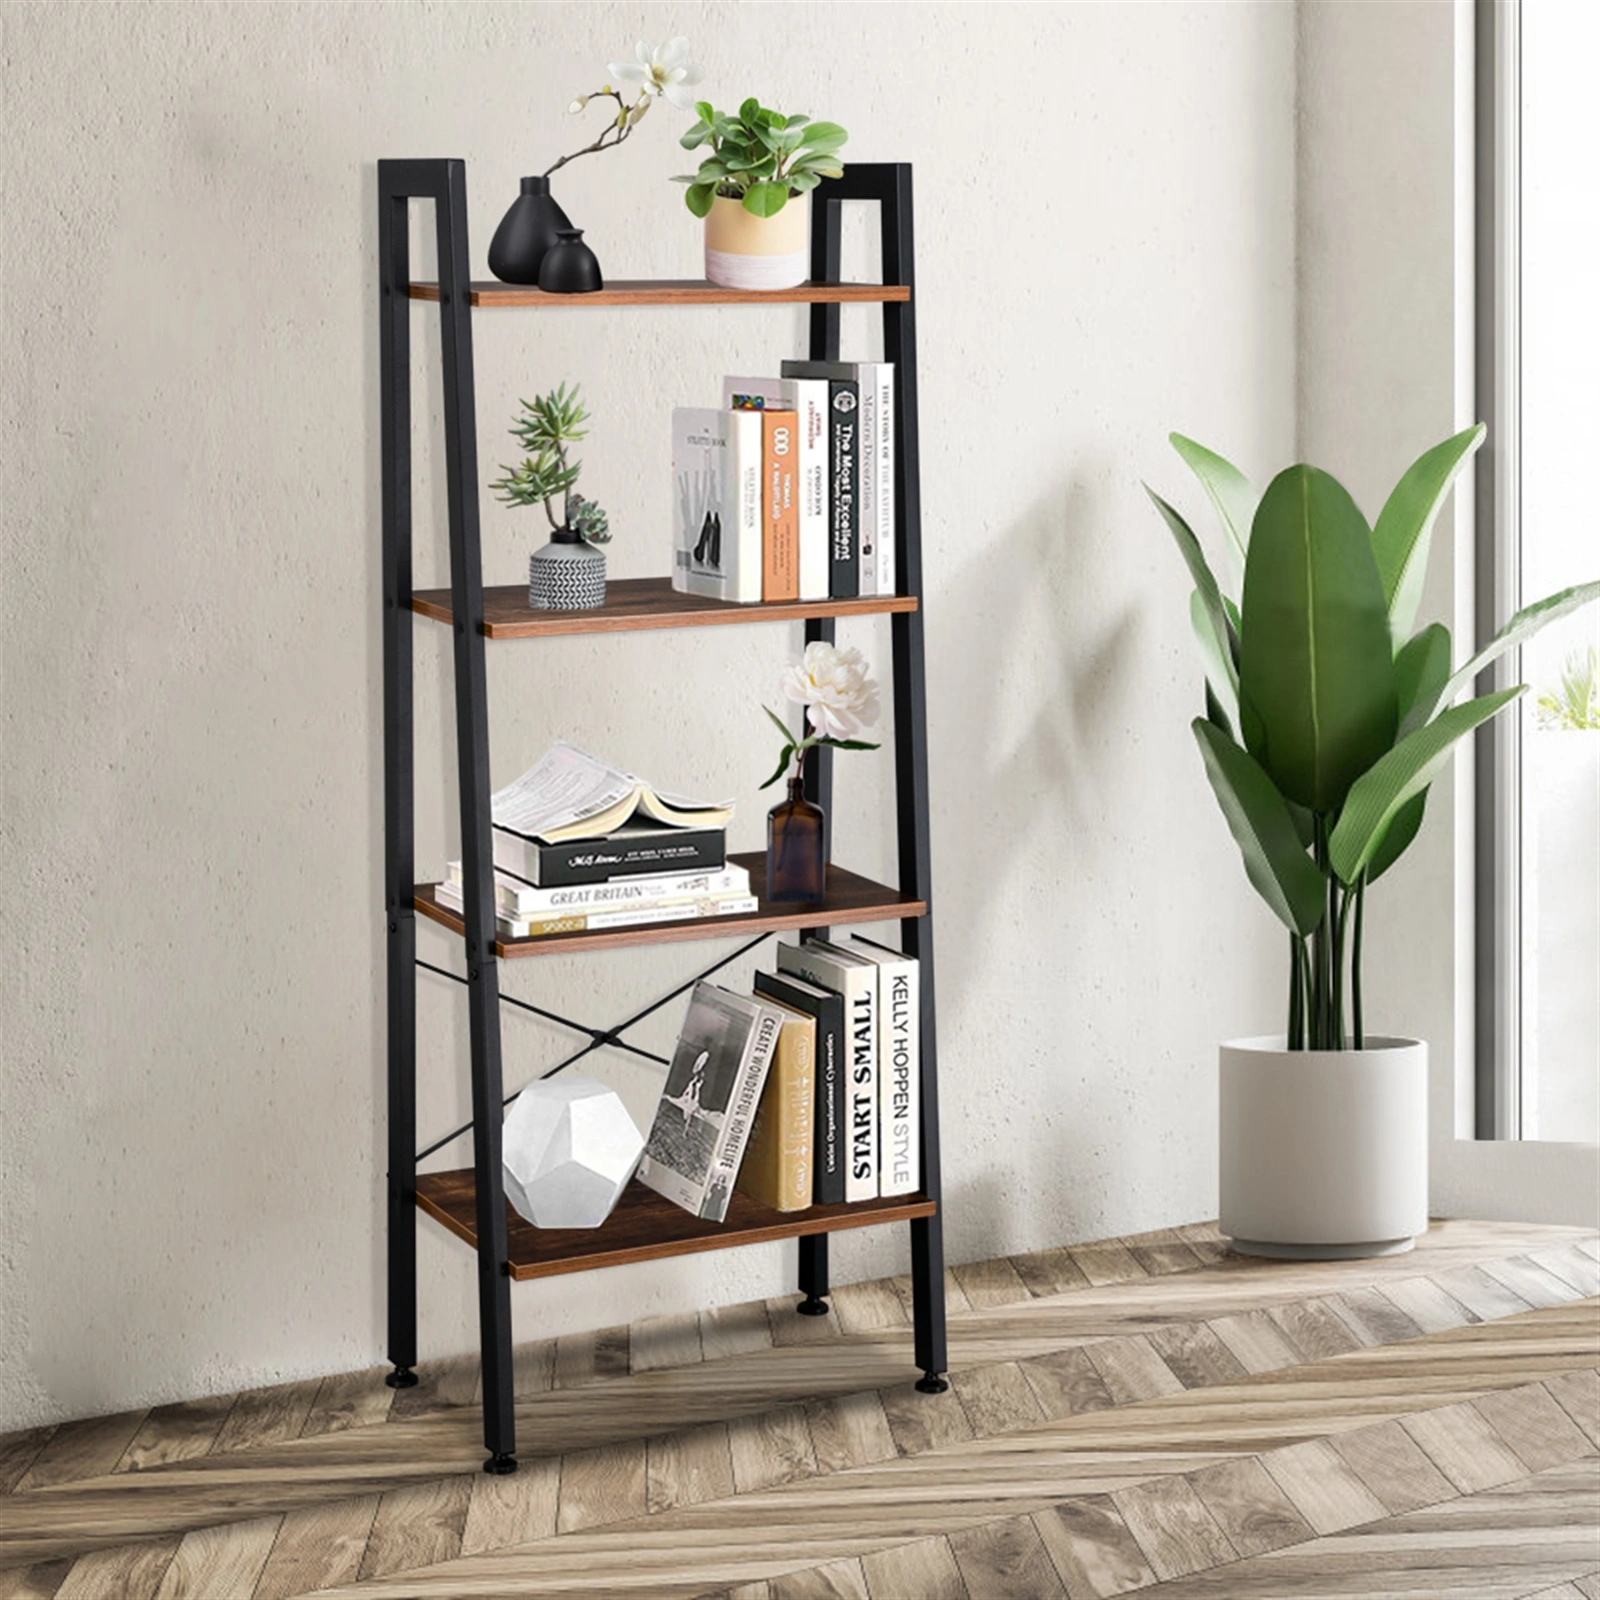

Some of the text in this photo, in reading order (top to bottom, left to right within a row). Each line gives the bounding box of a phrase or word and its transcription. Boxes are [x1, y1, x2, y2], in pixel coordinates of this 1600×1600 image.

[840, 424, 853, 561] The Most Excellent
[863, 394, 874, 511] Modern Decoration
[882, 446, 889, 460] OF
[882, 464, 890, 484] THE
[550, 889, 590, 906] GREAT
[593, 886, 643, 903] BRITAIN
[720, 1017, 776, 1169] CREATE WONDERFUL HOMELIFE
[853, 991, 872, 1180] START SMALL
[893, 975, 910, 1185] KELLY HOPPEN STYLE
